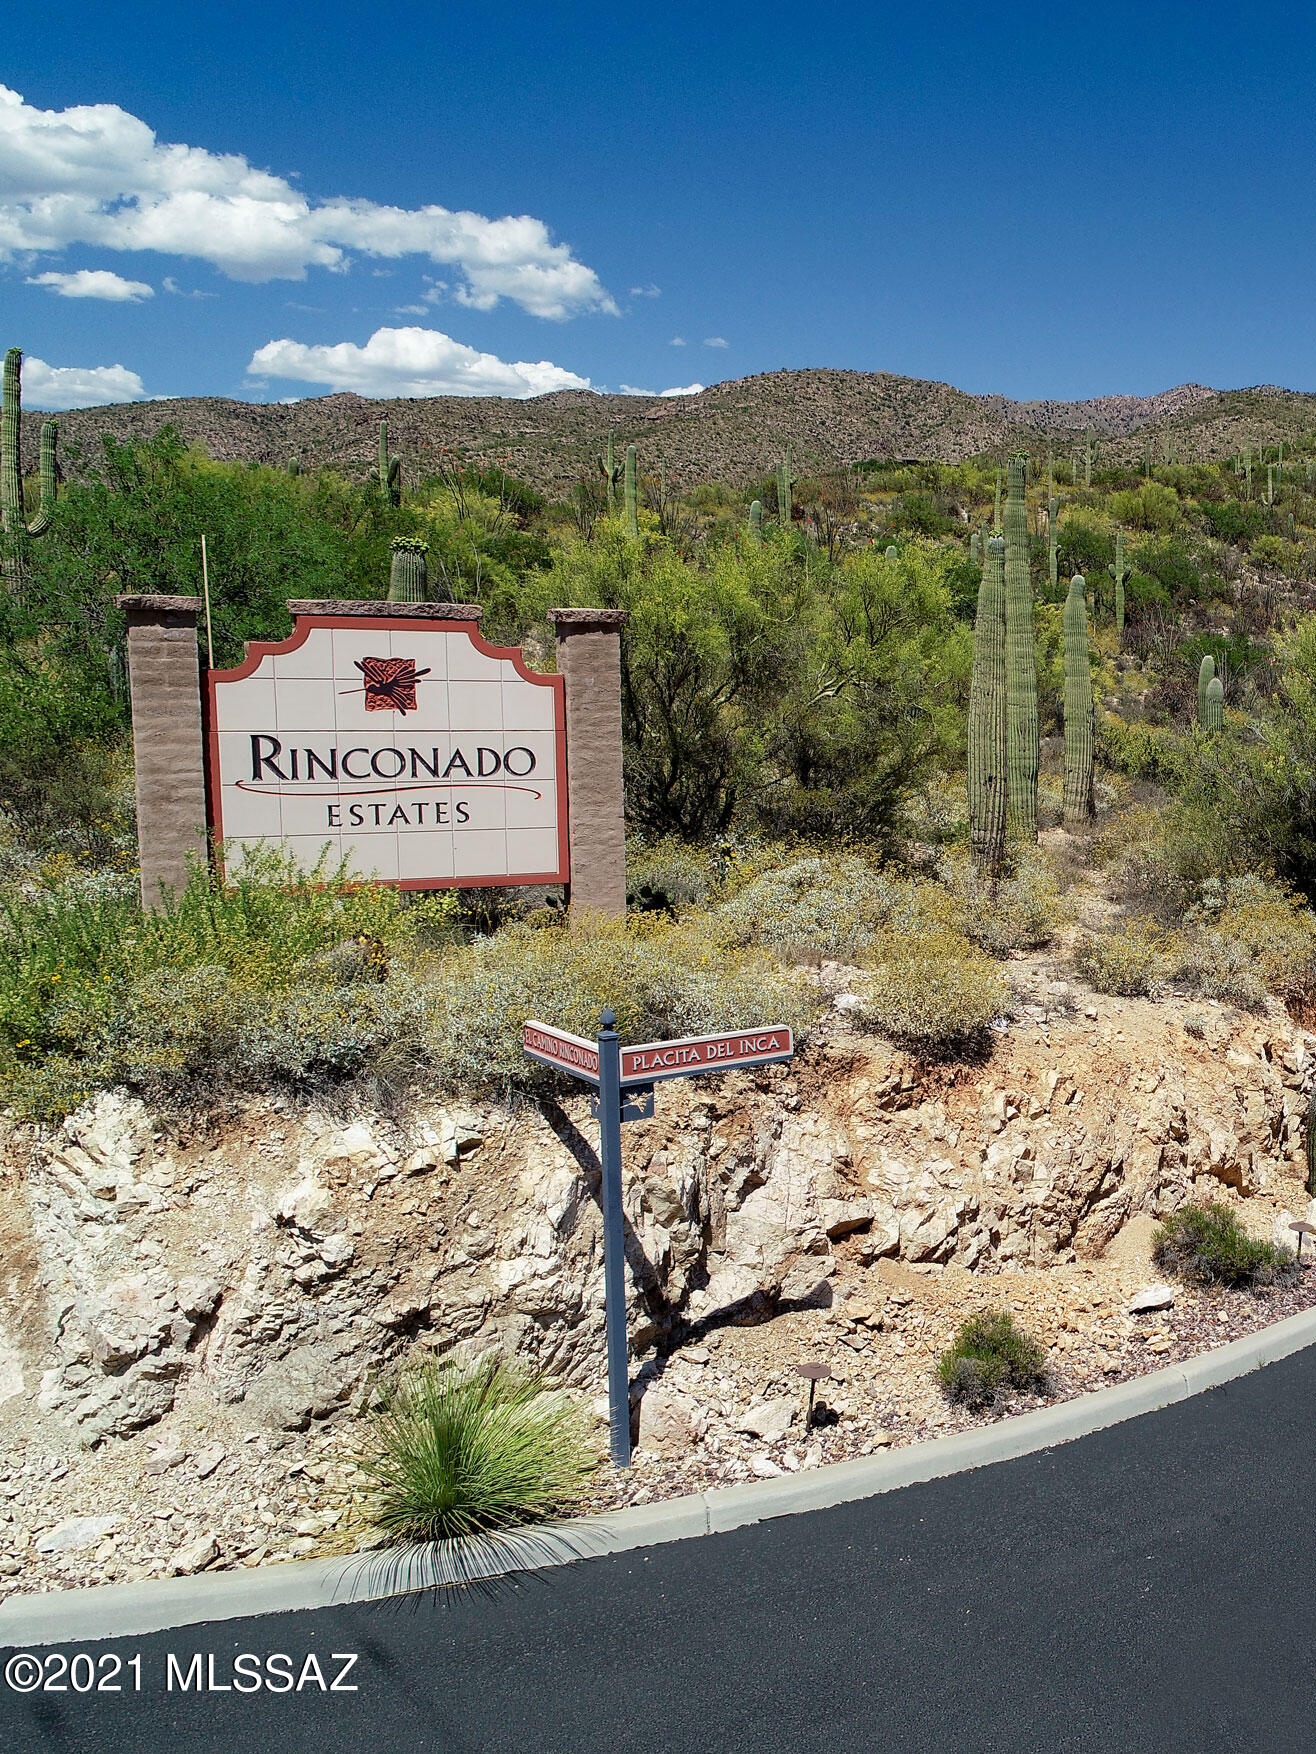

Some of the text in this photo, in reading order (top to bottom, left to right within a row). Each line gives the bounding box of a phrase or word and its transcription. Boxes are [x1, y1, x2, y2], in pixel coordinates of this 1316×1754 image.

[249, 734, 537, 781] RINCONADO
[327, 801, 471, 828] ESTATES
[525, 1029, 598, 1071] EL CAMINO RINCONADO
[632, 1035, 780, 1071] PLACITA DEL INCA
